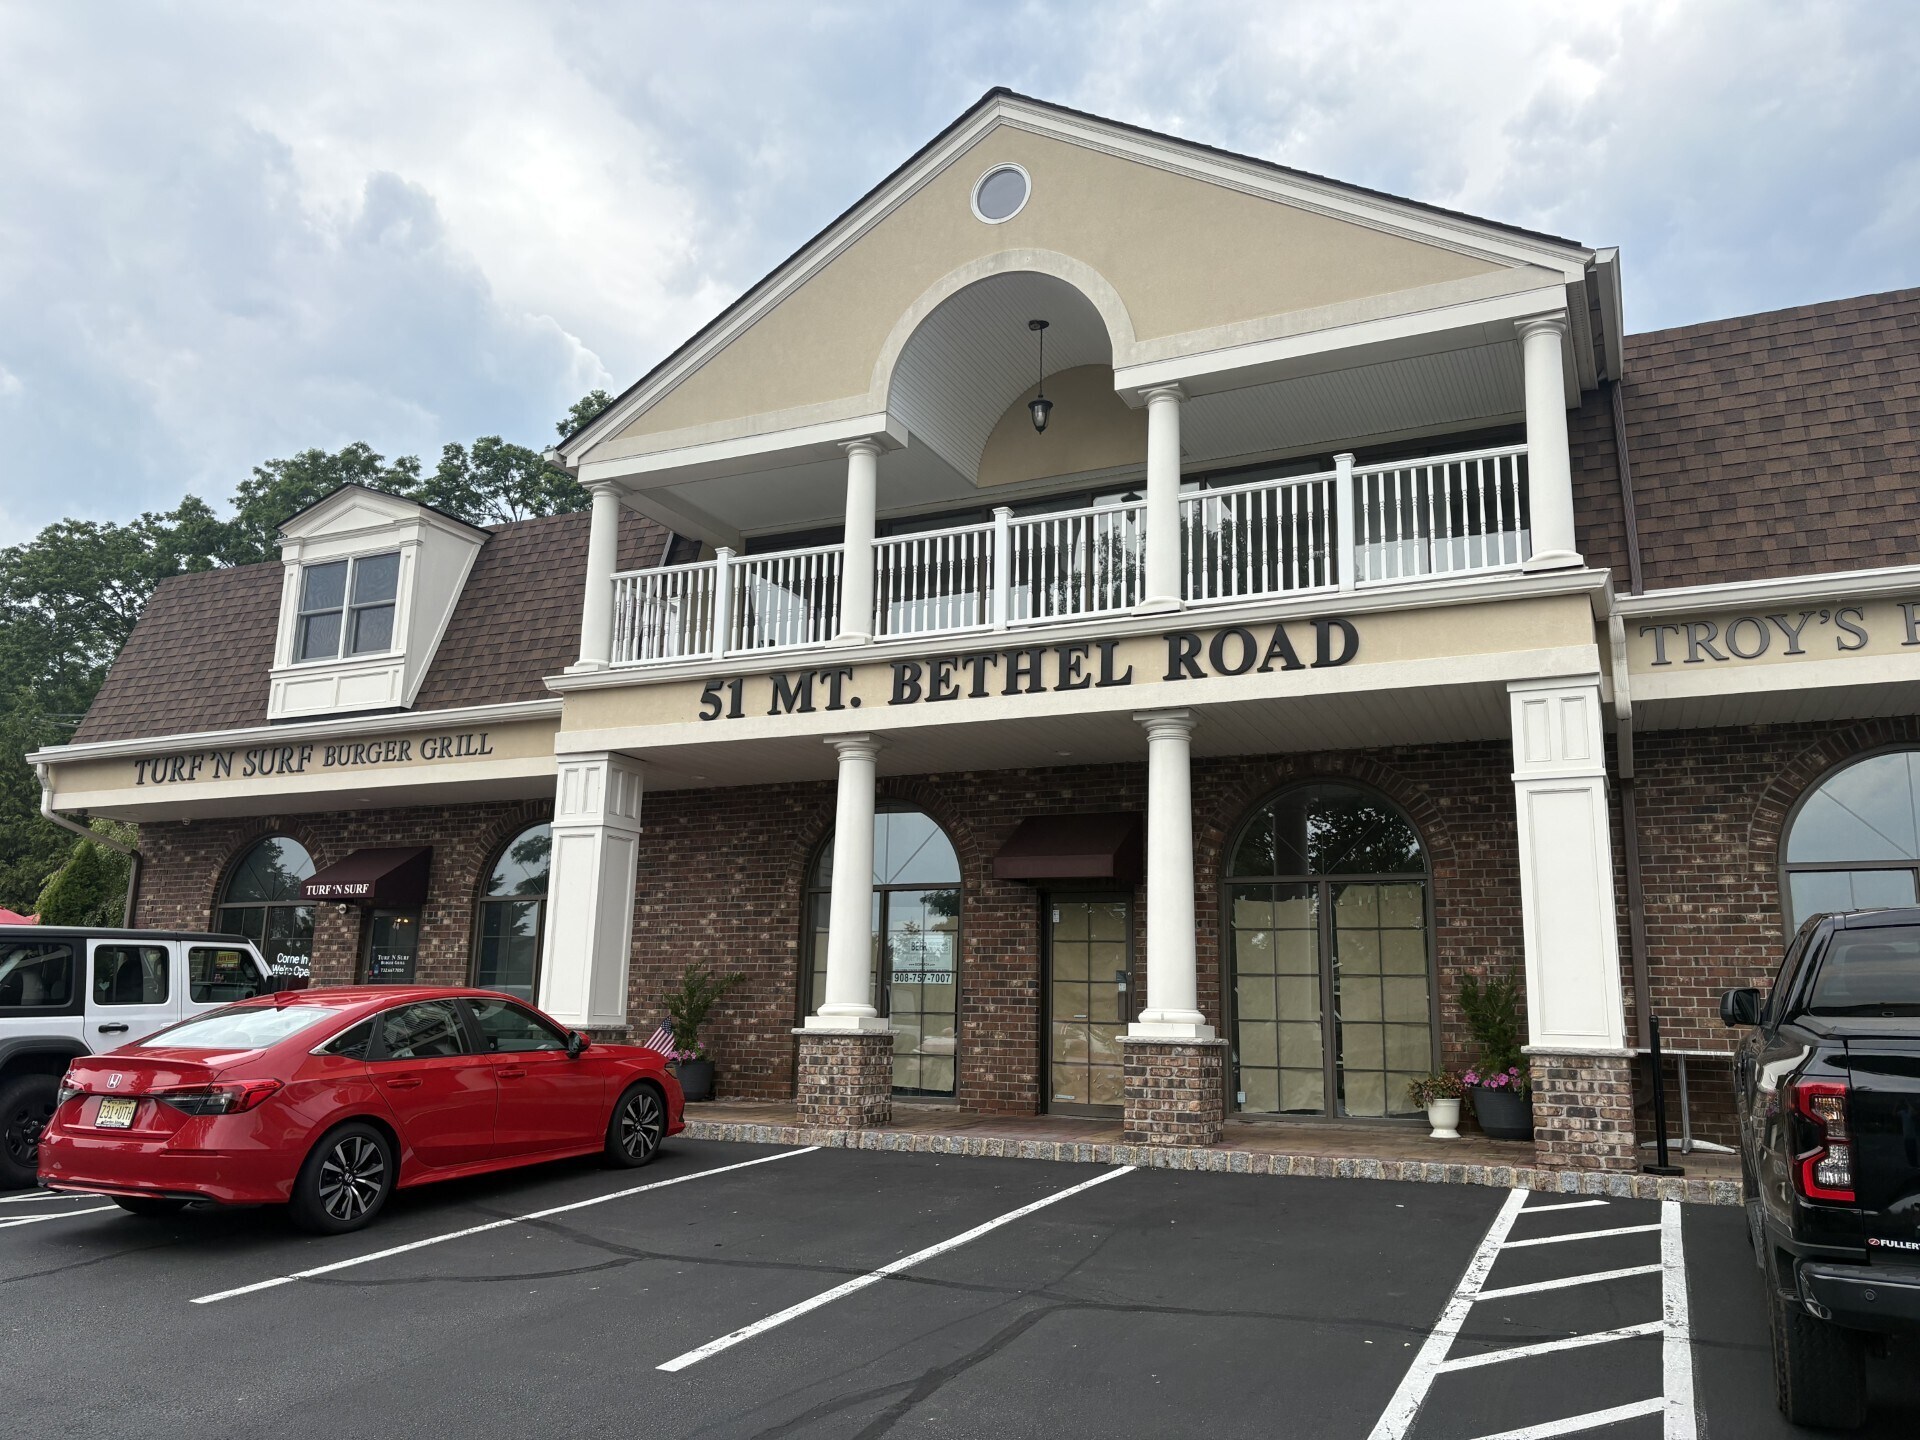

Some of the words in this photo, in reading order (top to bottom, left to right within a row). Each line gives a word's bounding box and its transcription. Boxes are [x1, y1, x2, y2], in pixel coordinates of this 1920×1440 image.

[1639, 606, 1868, 666] TROY'S
[699, 678, 745, 721] 51
[766, 667, 862, 716] MT.
[887, 640, 1133, 706] BETHEL
[1162, 618, 1360, 681] ROAD
[134, 754, 204, 785] TURF
[243, 744, 313, 777] SURF
[322, 739, 412, 767] BURGER
[419, 732, 493, 760] GRILL
[306, 884, 331, 895] TURF
[344, 883, 369, 894] SURF
[277, 952, 300, 965] Come
[293, 965, 310, 978] Ope
[894, 973, 951, 983] 908-757-7007
[1880, 1239, 1920, 1250] FULLER
